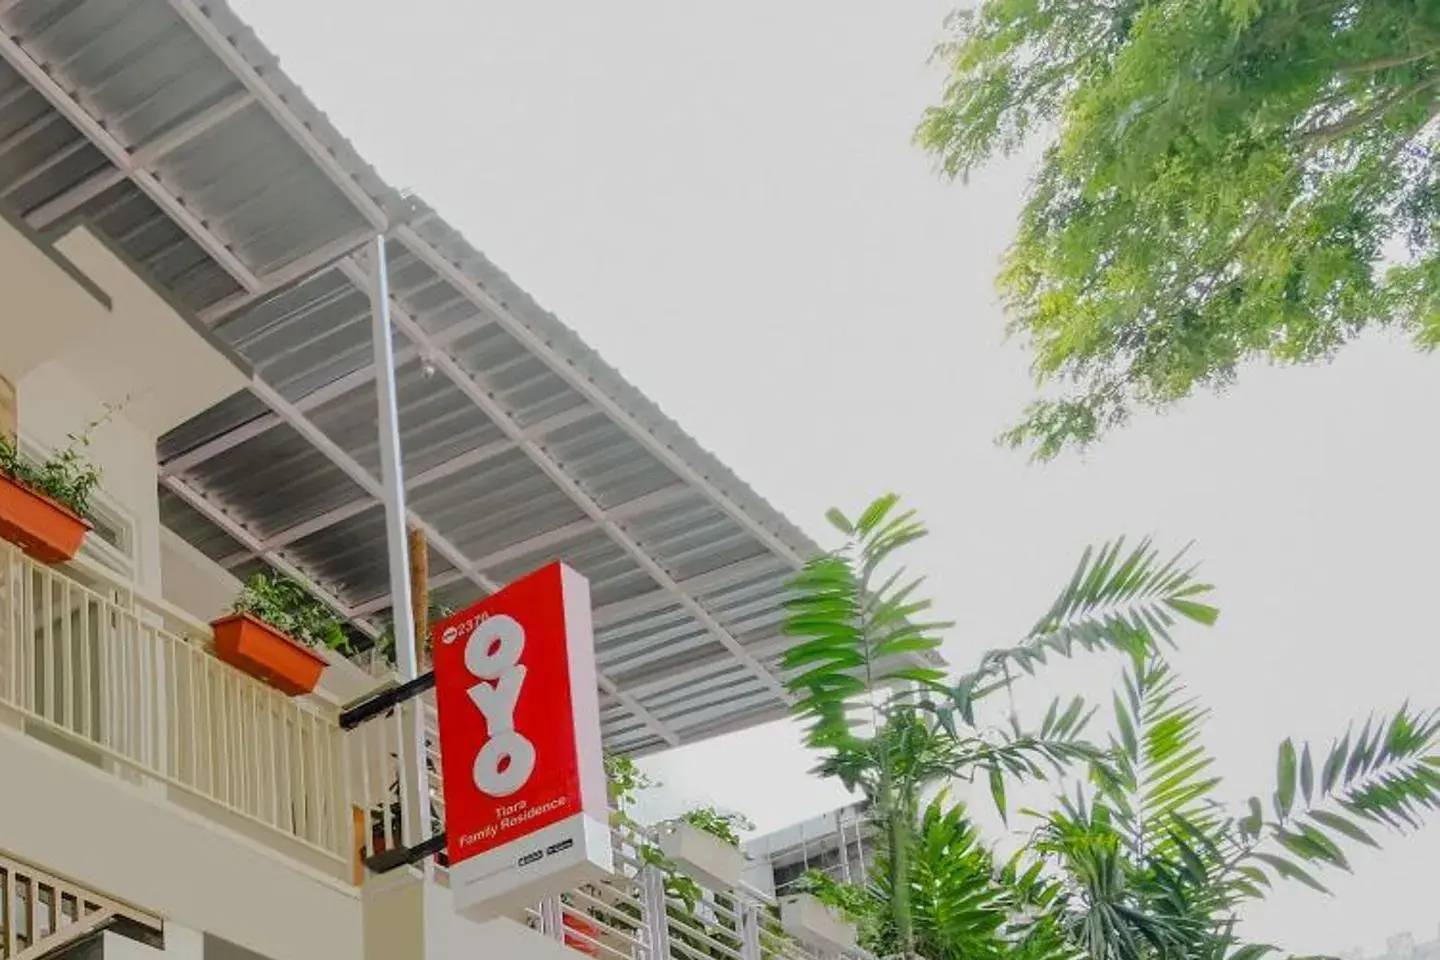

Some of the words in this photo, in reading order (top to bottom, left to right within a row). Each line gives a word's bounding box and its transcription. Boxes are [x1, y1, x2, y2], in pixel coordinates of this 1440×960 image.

[464, 613, 536, 798] OYO
[459, 824, 499, 849] Family
[500, 796, 567, 830] Residence
[495, 800, 527, 819] Tiara
